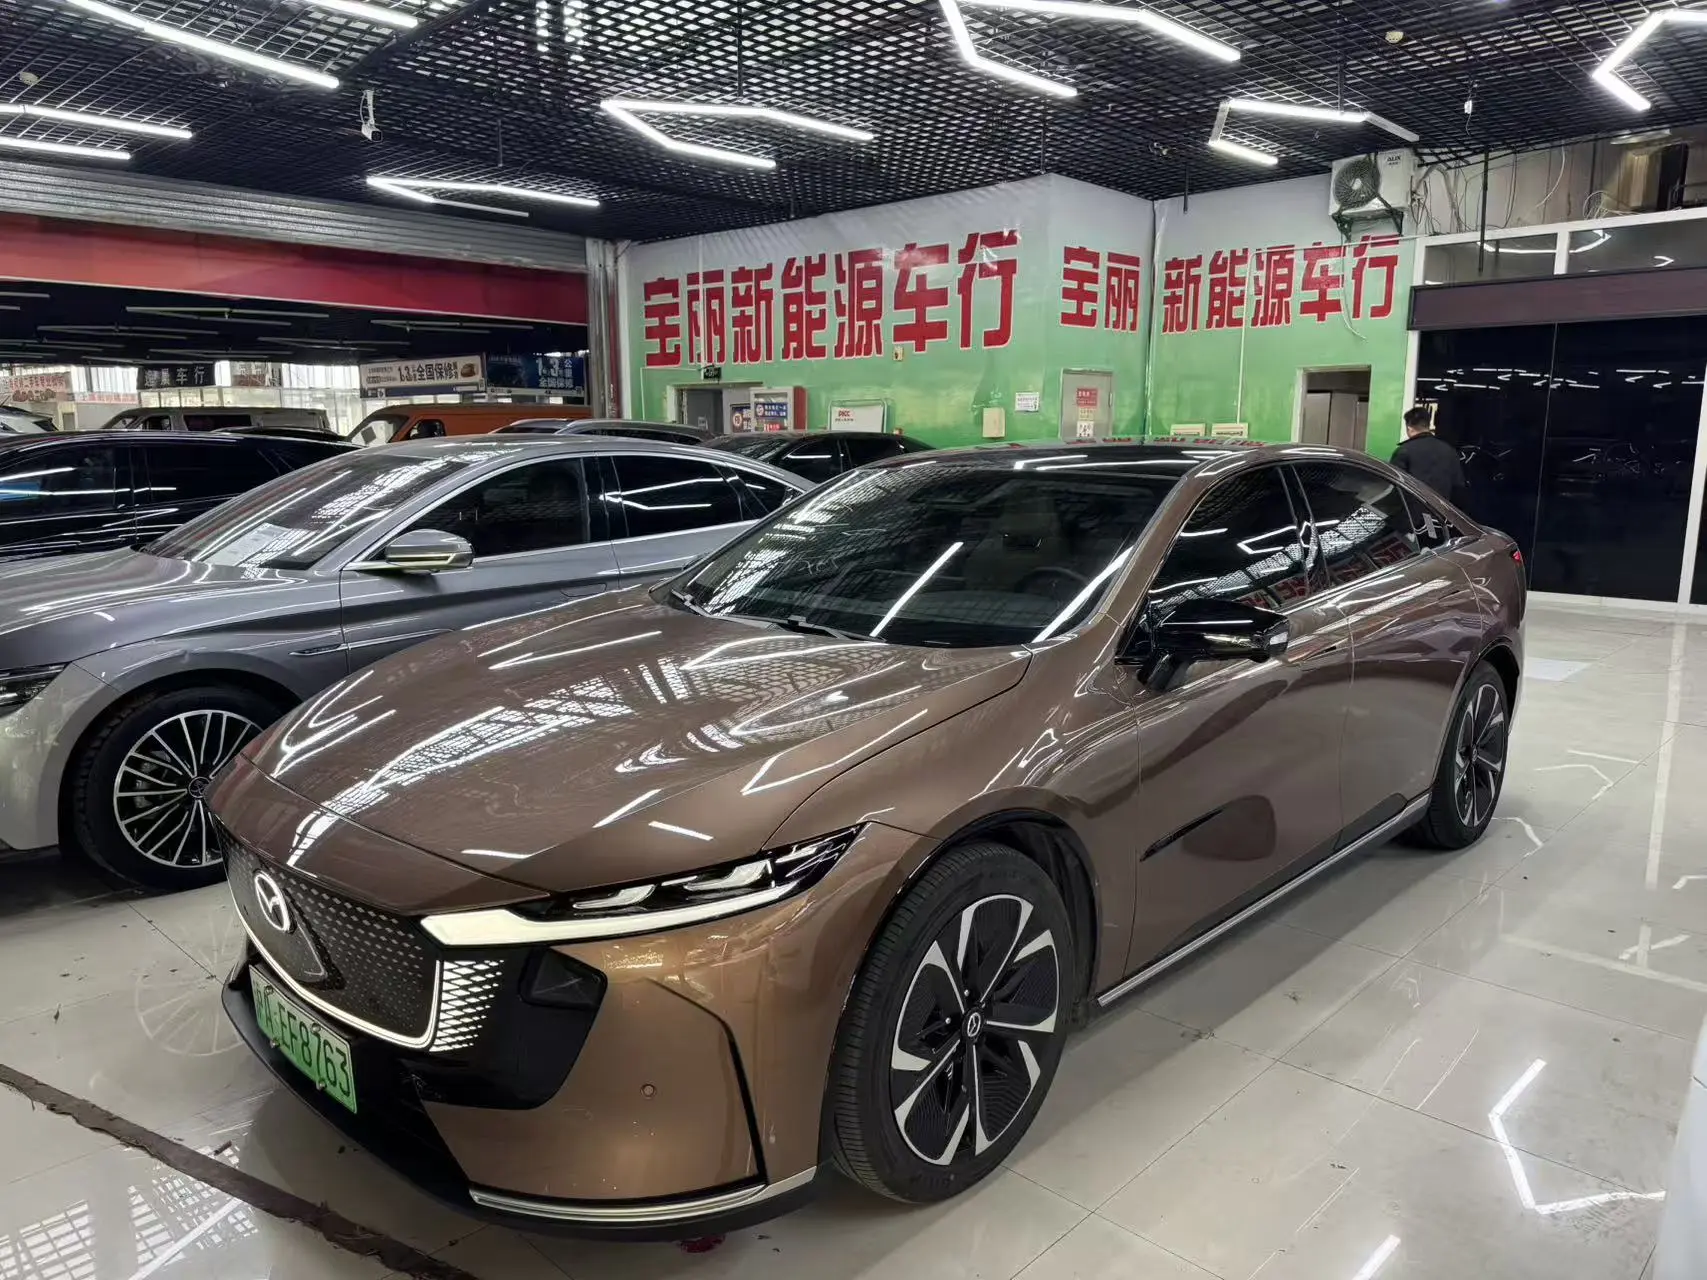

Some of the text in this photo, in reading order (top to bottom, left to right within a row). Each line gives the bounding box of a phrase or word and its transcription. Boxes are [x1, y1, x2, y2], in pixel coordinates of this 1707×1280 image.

[644, 230, 1018, 368] 宝丽新能源车行
[1061, 234, 1400, 334] 宝丽 新能源车行
